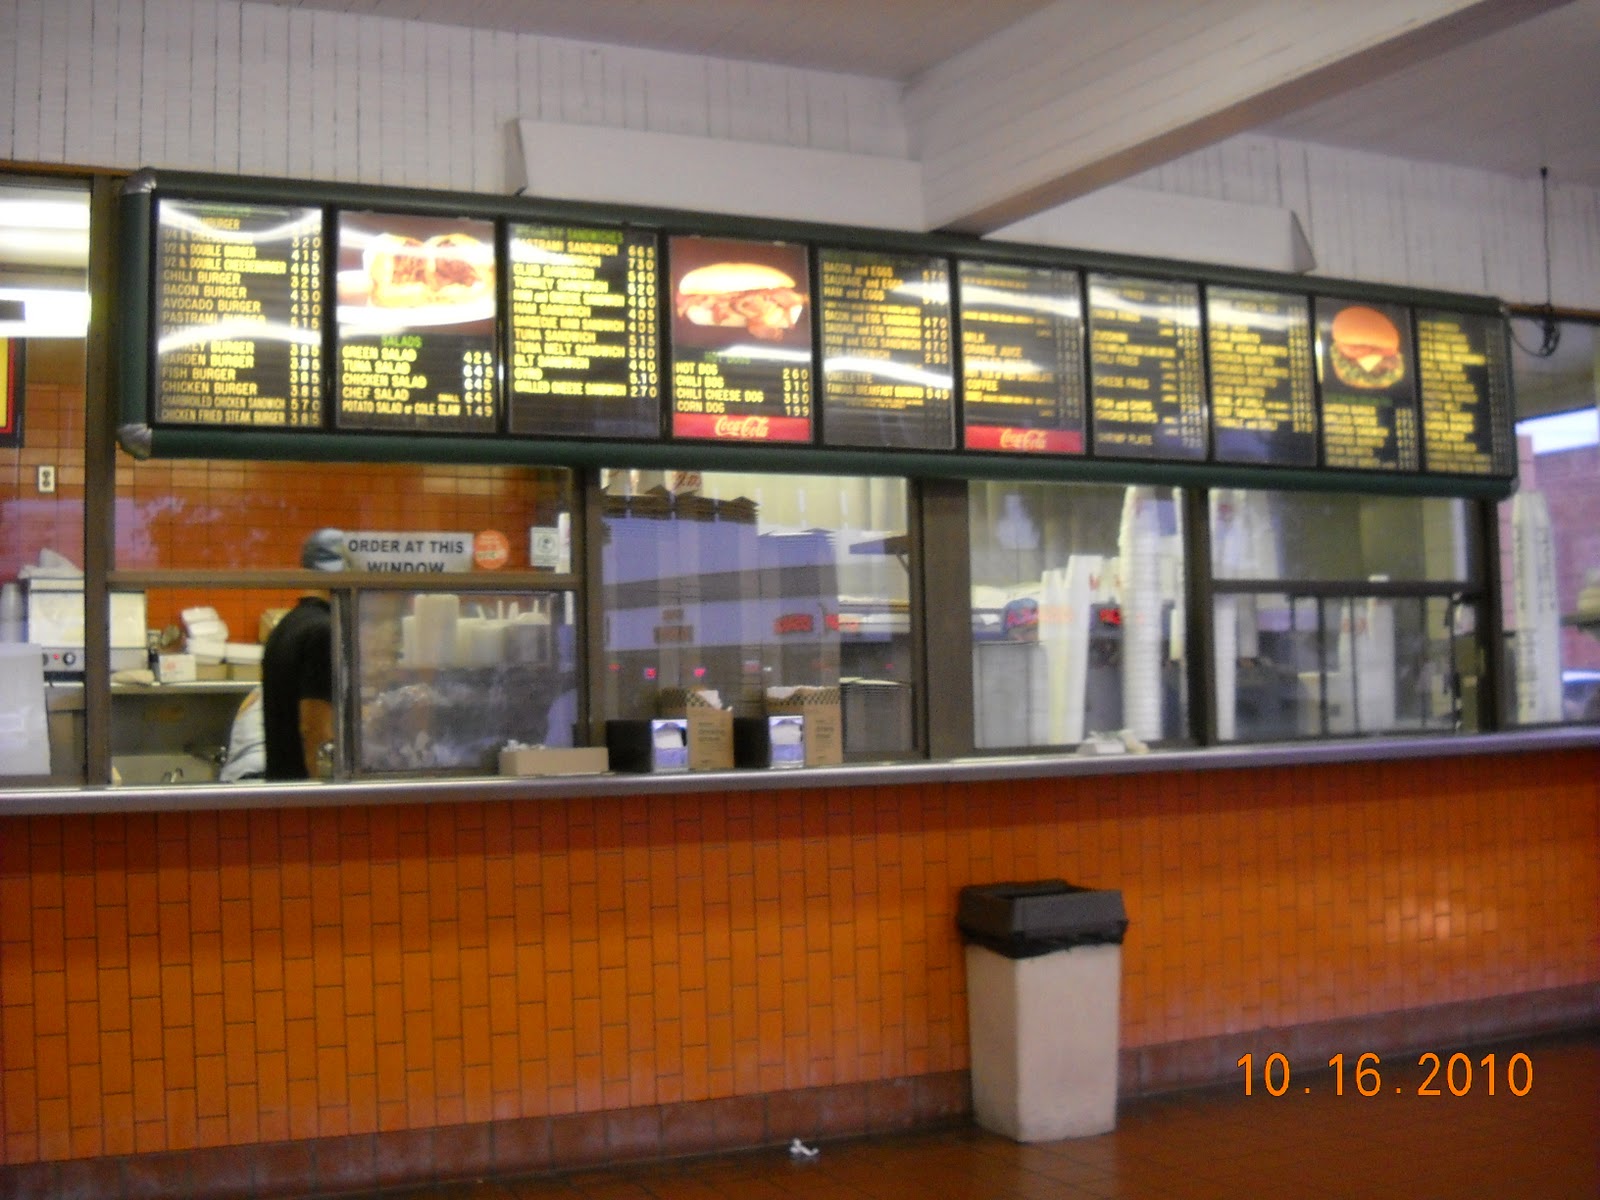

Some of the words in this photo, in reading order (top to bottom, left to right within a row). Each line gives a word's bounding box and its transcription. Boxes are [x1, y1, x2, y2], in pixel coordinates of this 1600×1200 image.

[163, 271, 193, 283] CHILI
[197, 273, 241, 285] BURGER
[163, 285, 199, 297] BACON
[203, 286, 247, 299] BURGER
[163, 298, 214, 311] AVOCADO
[218, 300, 261, 313] BURGER
[163, 312, 218, 324] PASTRAMI
[381, 347, 417, 362] SALAD
[192, 368, 236, 381] BURGER
[375, 360, 411, 375] SALAD
[676, 362, 695, 374] HOT
[698, 363, 718, 376] DOG
[162, 381, 209, 393] CHICKEN
[214, 382, 258, 396] BURGER
[391, 374, 427, 389] SALAD
[676, 375, 702, 388] CHILI
[704, 376, 725, 389] DOG
[342, 386, 371, 399] CHEF
[374, 387, 410, 401] SALAD
[676, 387, 702, 400] CHILI
[705, 388, 741, 402] CHEESE
[744, 390, 764, 403] DOG
[677, 400, 703, 413] CORN
[705, 402, 725, 414] DOG
[348, 539, 398, 553] ORDER
[404, 540, 424, 553] AT
[430, 541, 464, 554] THIS
[367, 562, 444, 573] WINDOW
